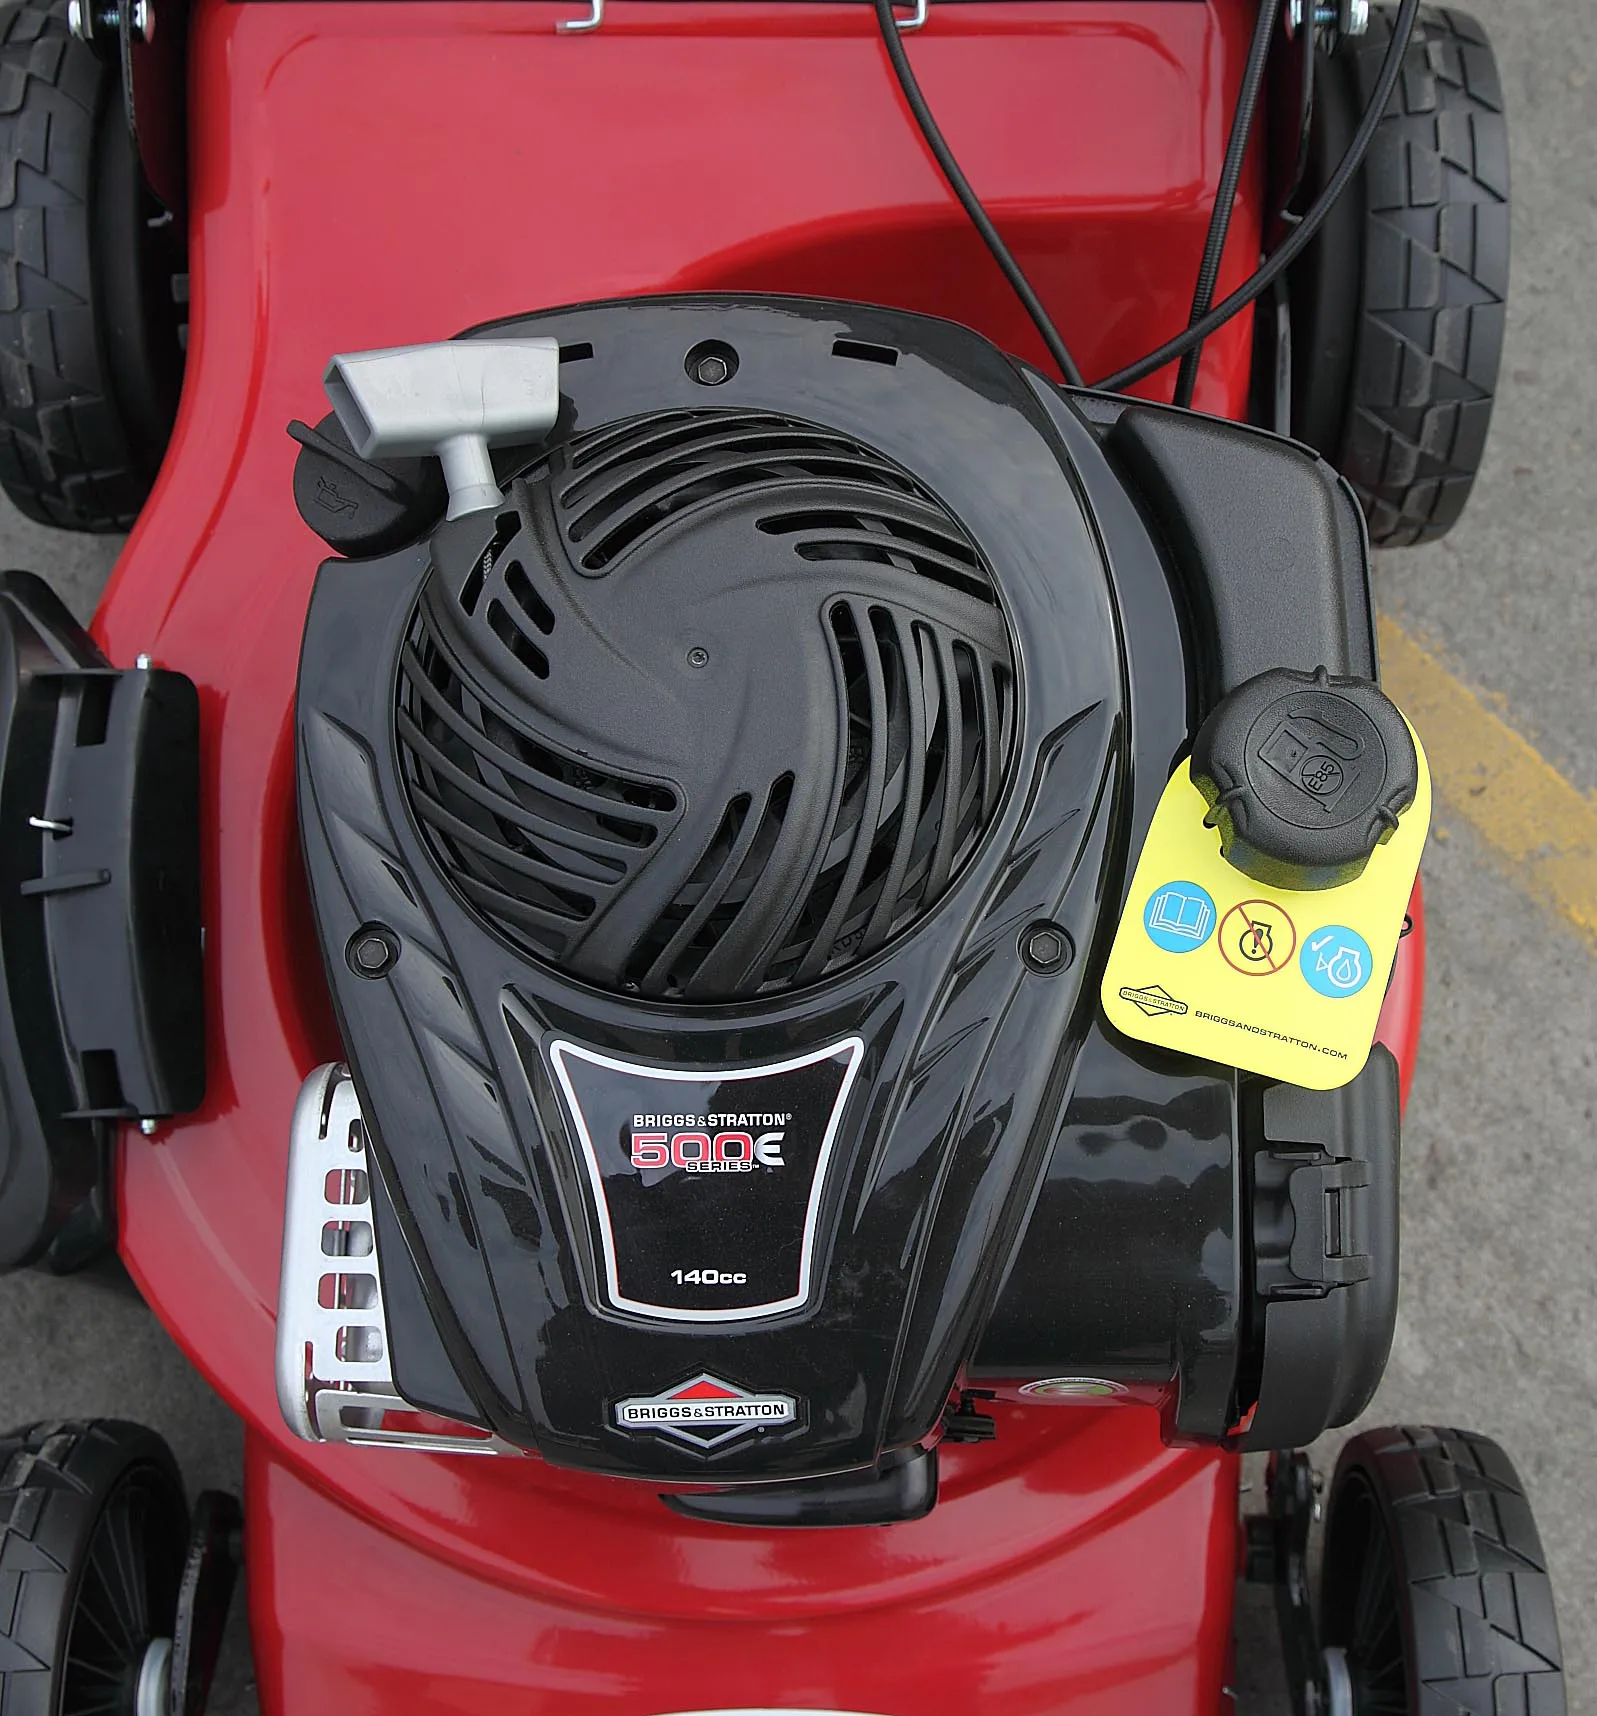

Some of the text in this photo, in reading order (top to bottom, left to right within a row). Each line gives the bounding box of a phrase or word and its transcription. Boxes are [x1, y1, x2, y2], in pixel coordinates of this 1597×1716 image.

[1307, 760, 1336, 792] E85
[1195, 1010, 1348, 1060] BRIGGSANDSTRATTON.COM
[670, 1269, 747, 1285] 140cc
